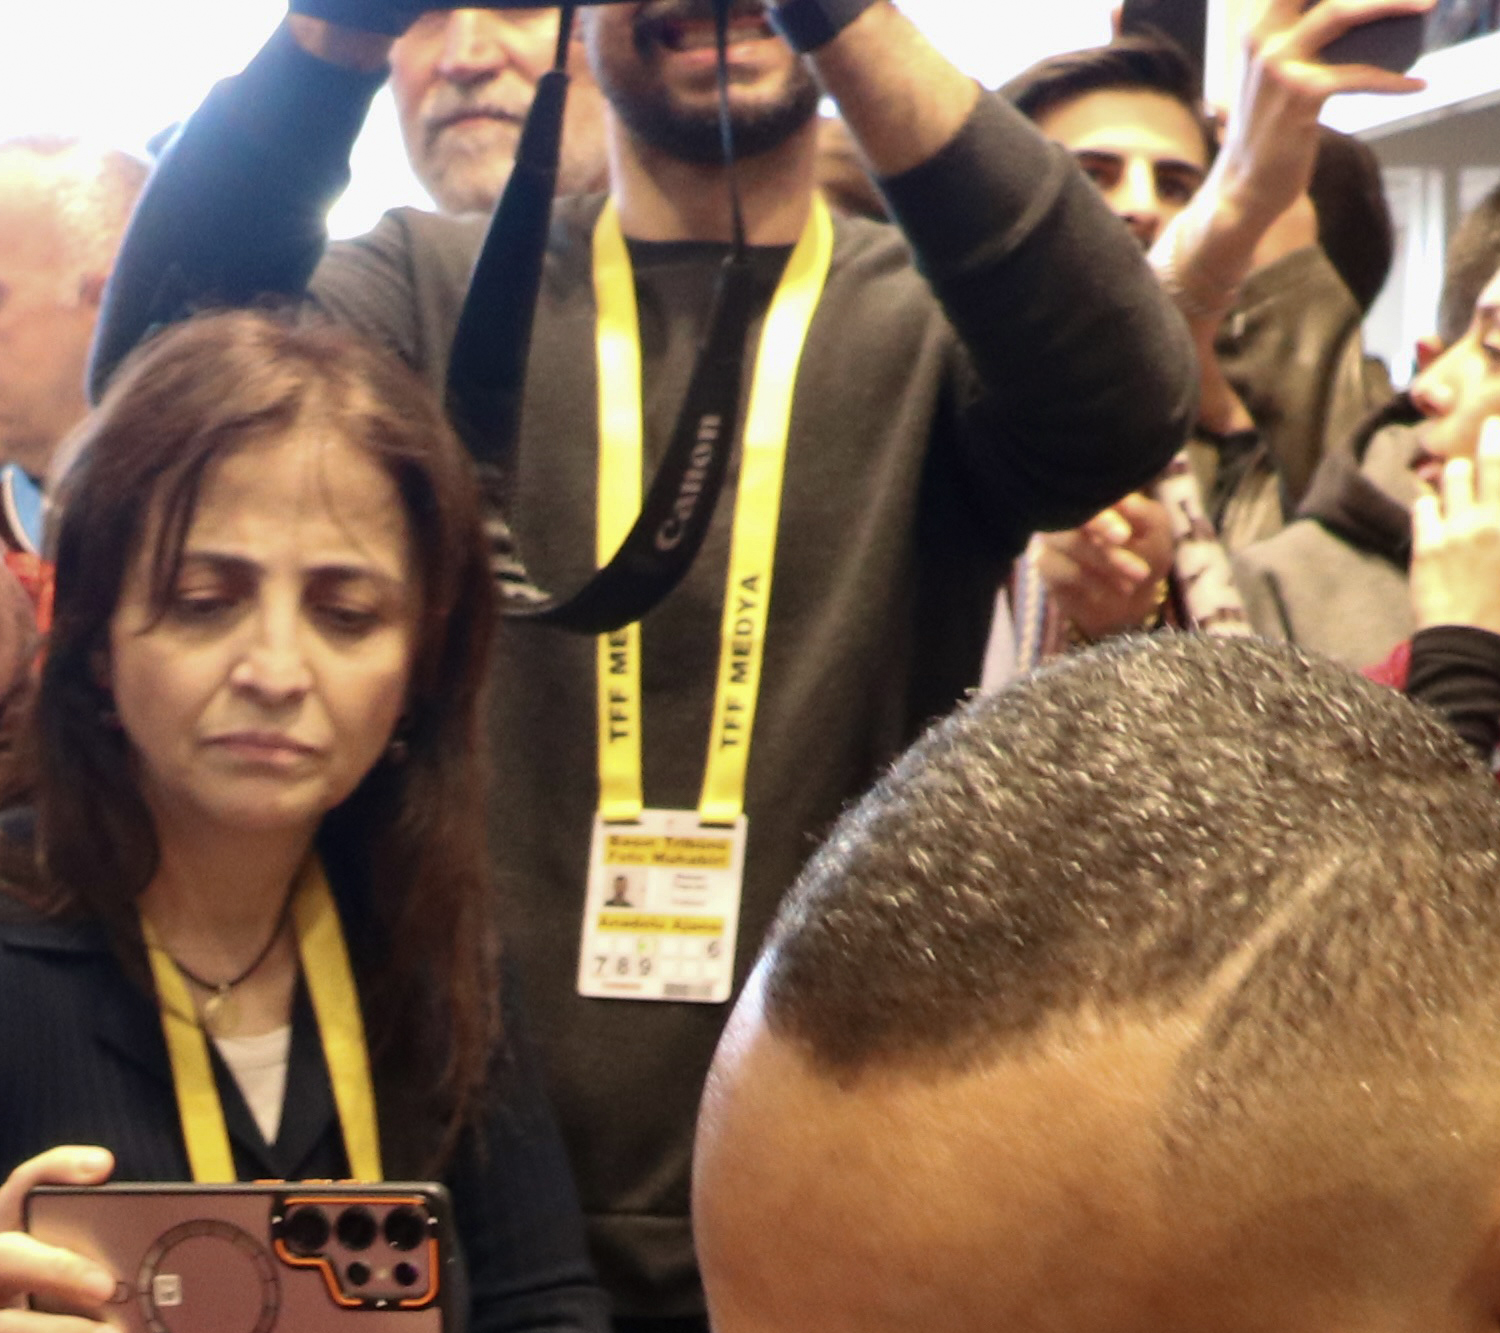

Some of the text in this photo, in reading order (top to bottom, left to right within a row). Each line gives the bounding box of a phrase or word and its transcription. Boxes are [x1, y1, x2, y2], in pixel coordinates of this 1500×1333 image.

[654, 413, 722, 551] Canon
[610, 688, 630, 743] TFF
[720, 573, 761, 750] TFF MEDYA
